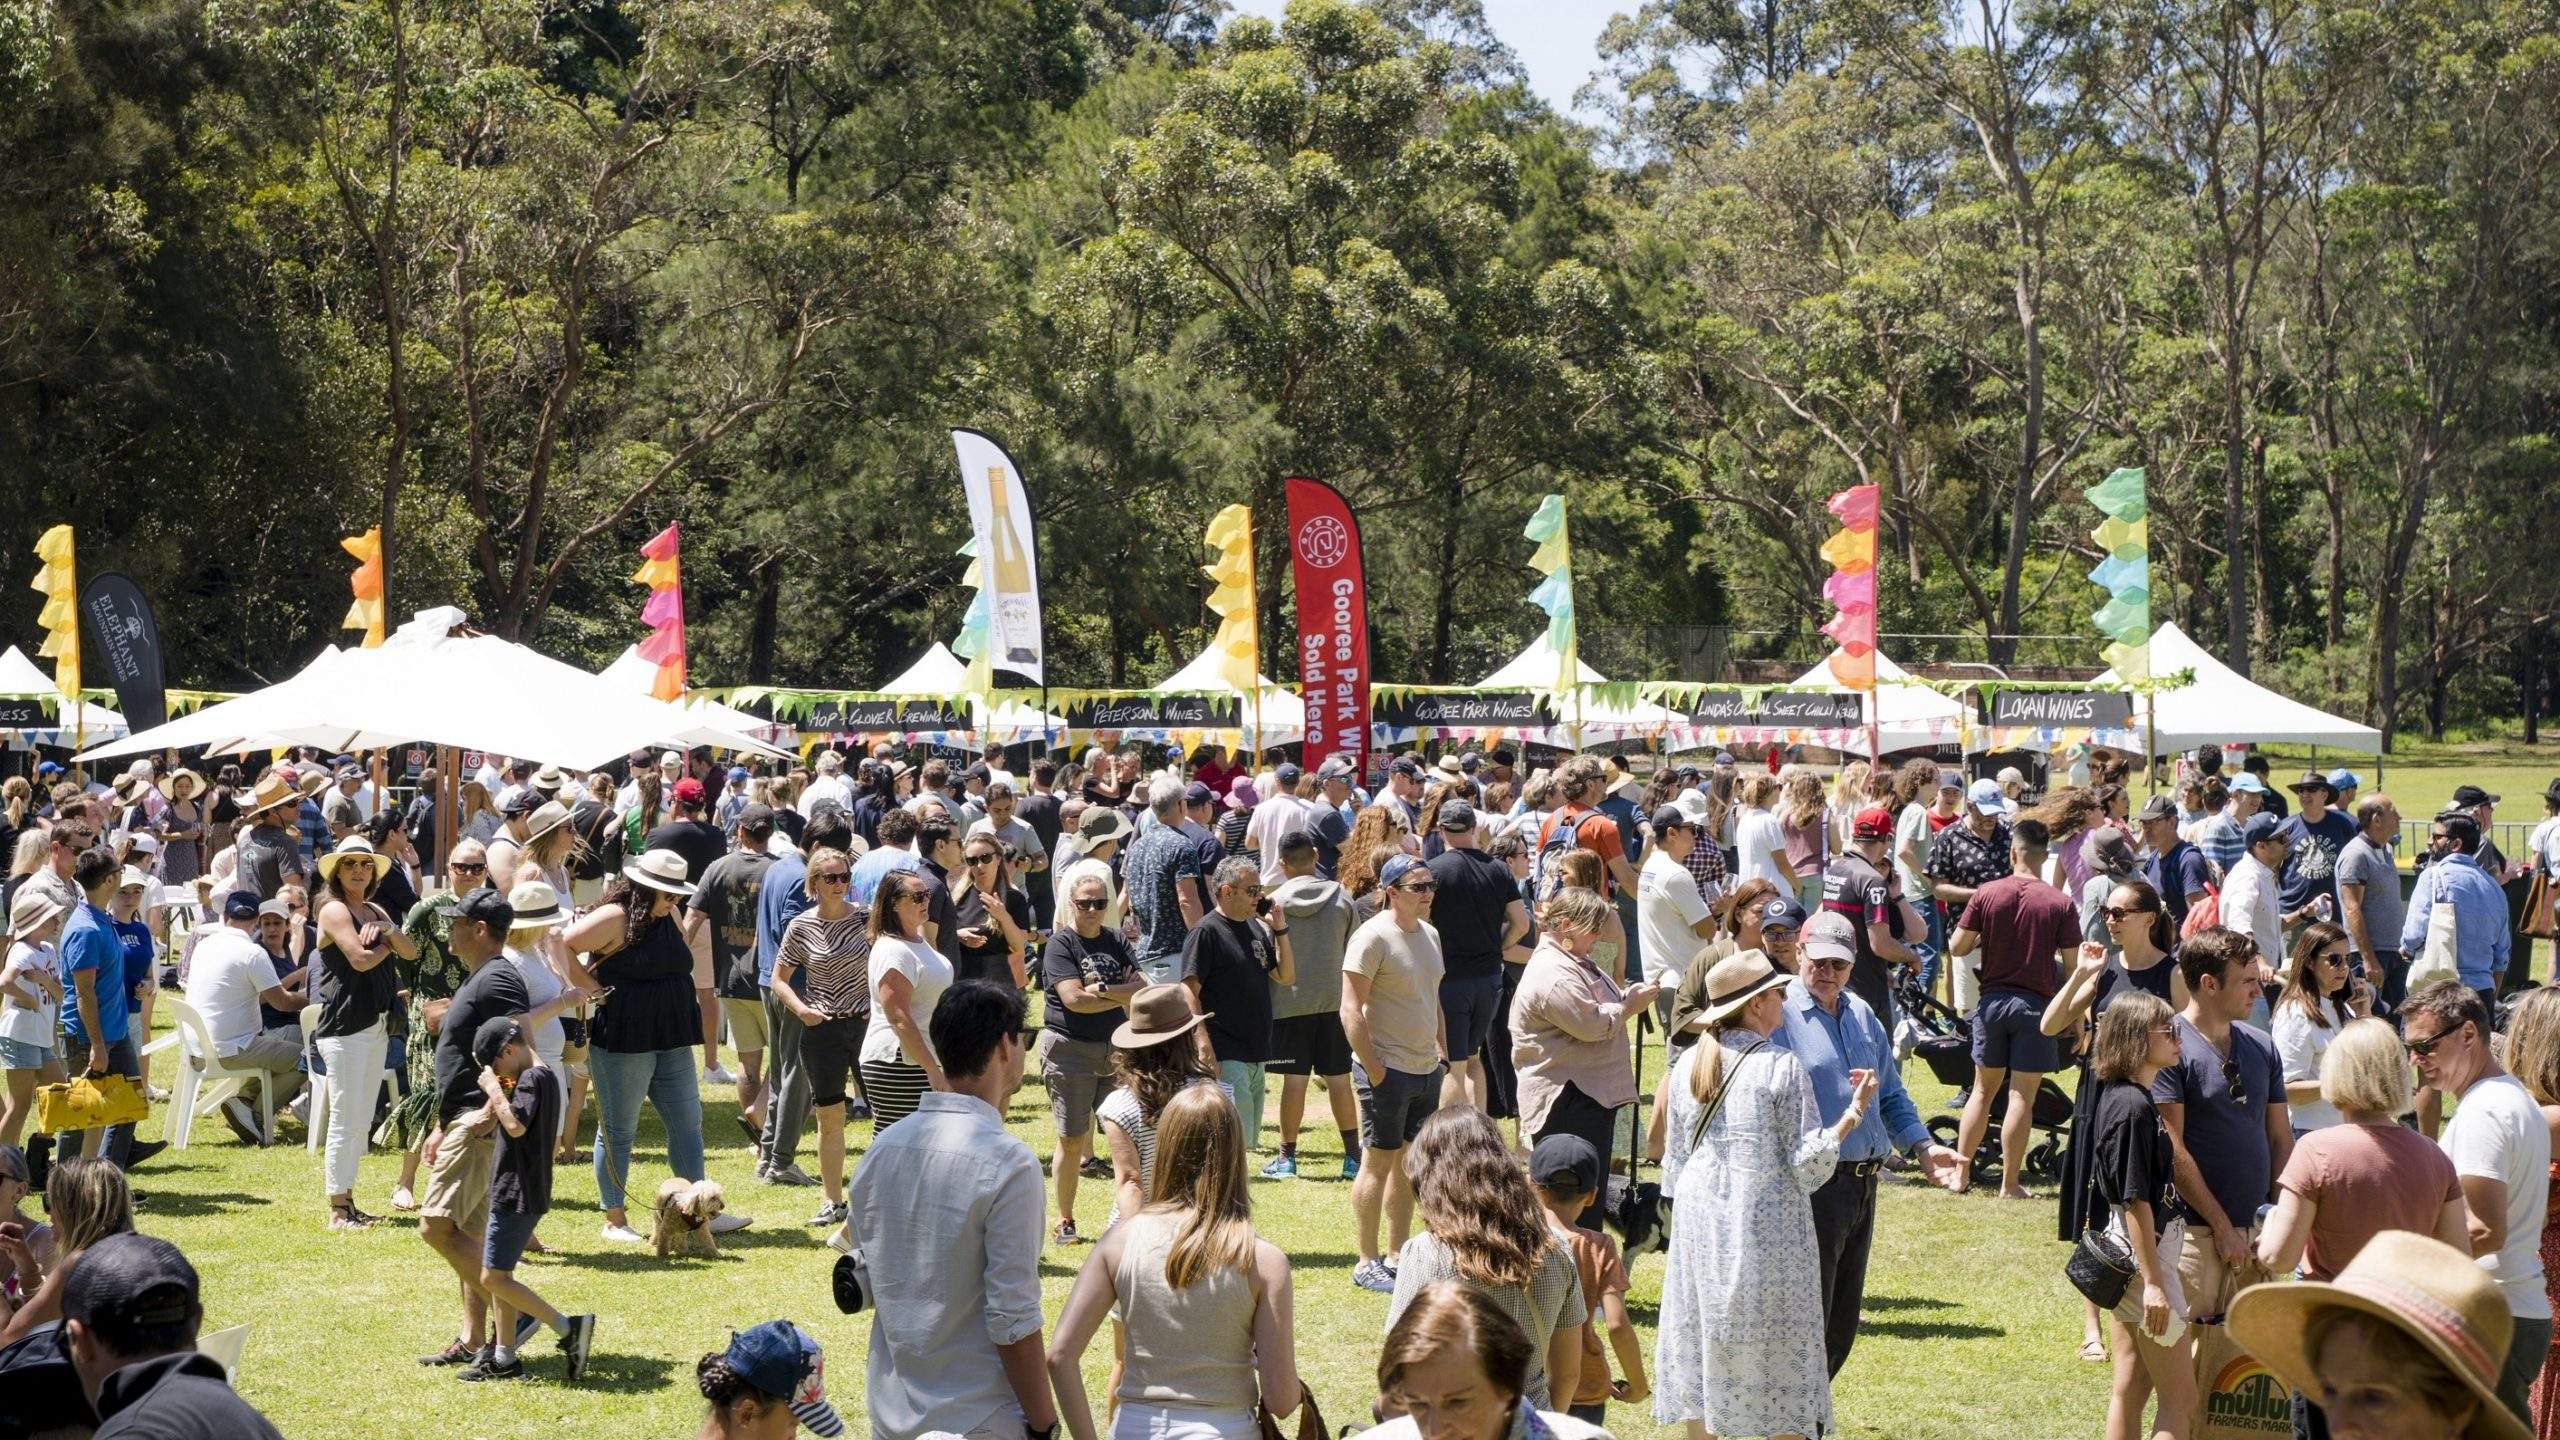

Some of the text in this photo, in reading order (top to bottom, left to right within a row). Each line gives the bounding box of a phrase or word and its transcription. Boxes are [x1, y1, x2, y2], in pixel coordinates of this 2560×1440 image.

[90, 600, 128, 683] MOUNTAIN WINES
[99, 593, 140, 678] ELEPHANT
[1332, 578, 1362, 756] Gooree Park Wi
[1304, 633, 1327, 744] Sold Here
[0, 708, 31, 721] ESS
[809, 711, 837, 727] HOP
[851, 708, 894, 726] CLOVER
[898, 708, 941, 726] BREWING
[1165, 702, 1204, 720] WINES
[1415, 701, 1533, 721] GOOREE PARK WINES
[1697, 699, 1734, 717] LINDA'S
[1773, 700, 1804, 717] SWEET
[2000, 696, 2095, 720] LOGAN WINES
[1936, 744, 1961, 755] SWEE
[2295, 834, 2336, 852] BRUGGE
[1869, 886, 1887, 905] 67
[2207, 1413, 2293, 1434] FARMERS MARK
